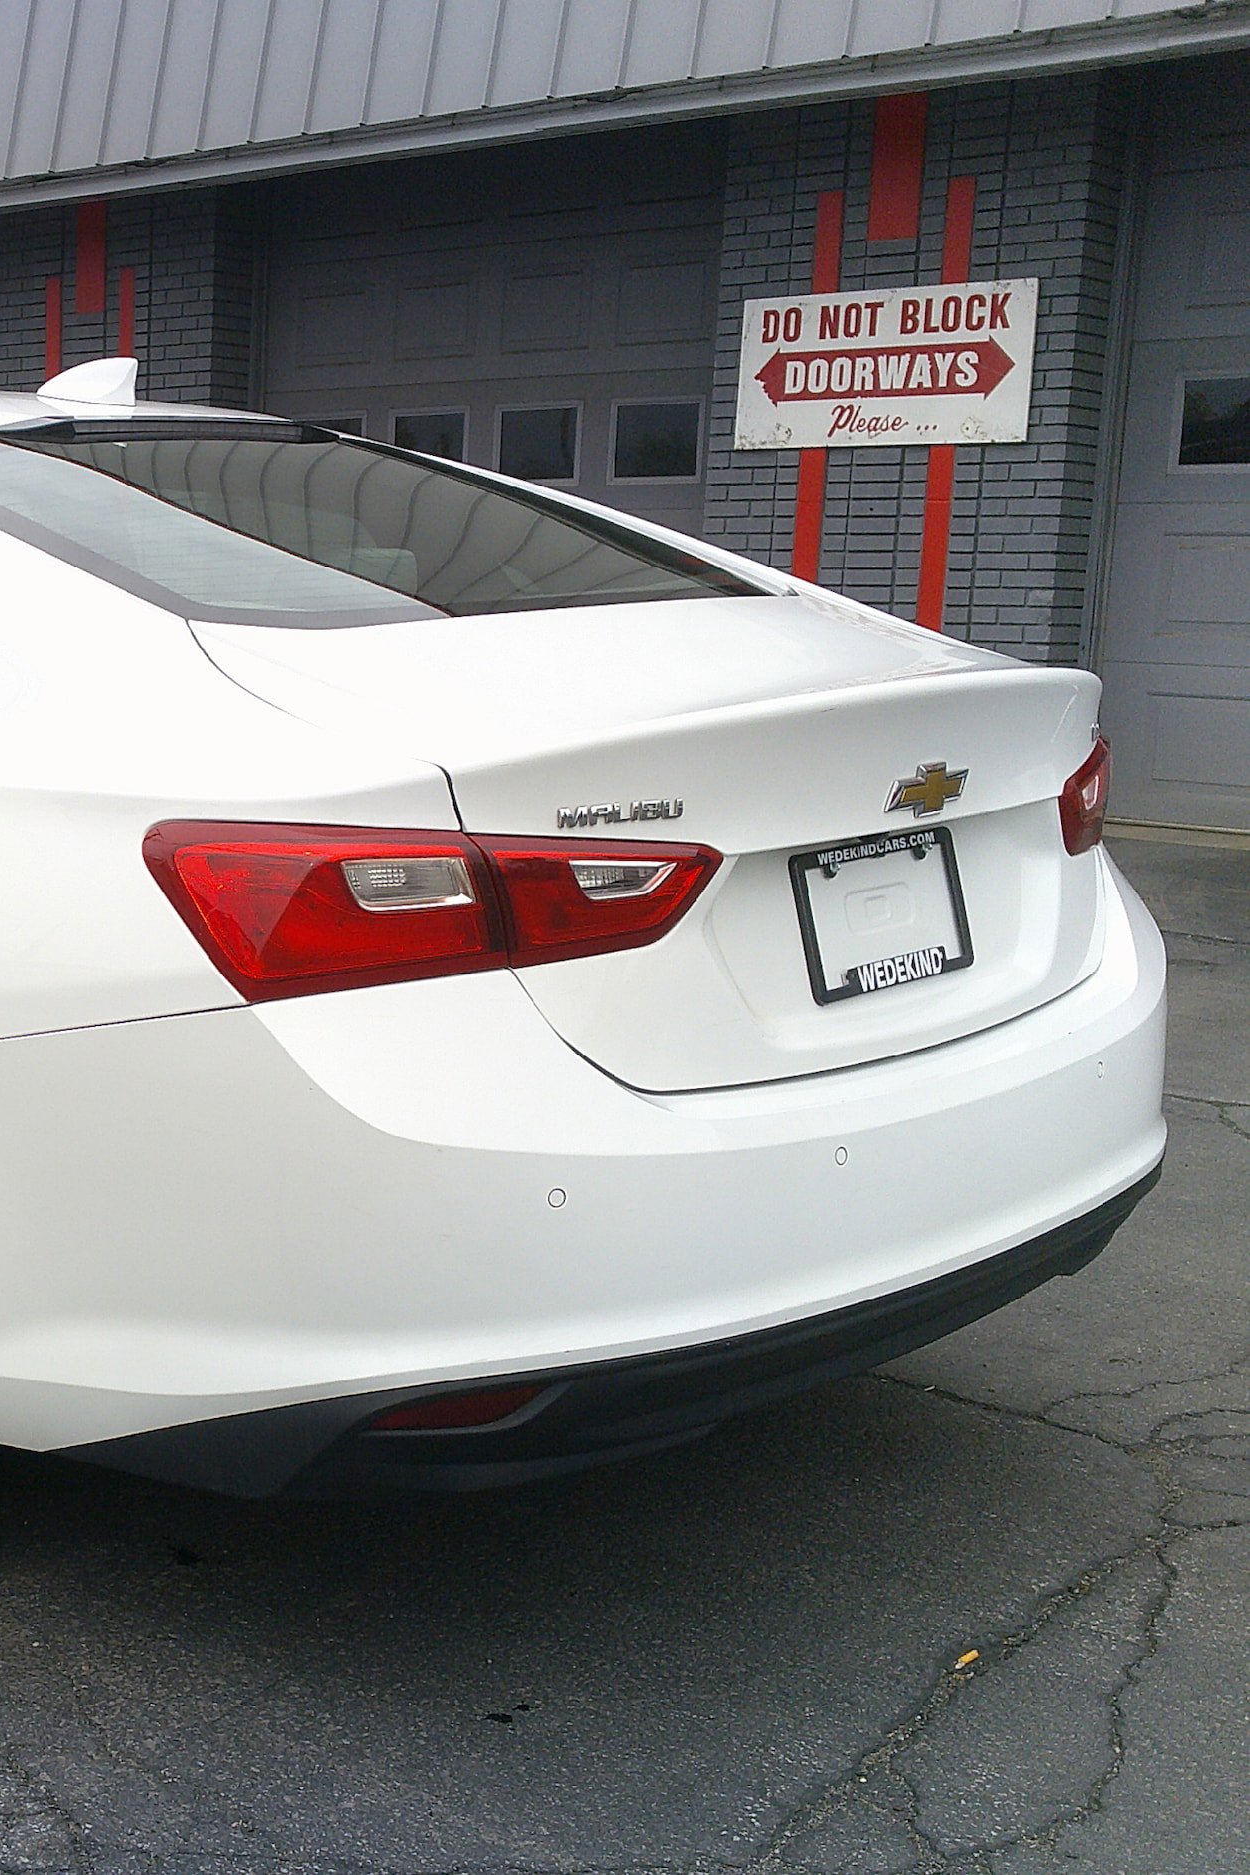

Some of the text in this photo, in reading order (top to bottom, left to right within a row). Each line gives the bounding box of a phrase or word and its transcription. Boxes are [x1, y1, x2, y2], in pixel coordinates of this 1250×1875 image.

[761, 292, 1012, 343] DO NOT BLOCK
[783, 351, 979, 394] DOORWAYS
[827, 404, 909, 438] Please
[557, 798, 684, 829] MALIBU
[817, 831, 936, 866] WEDEKINDCARS.COM
[857, 947, 943, 992] WEDEKIND
